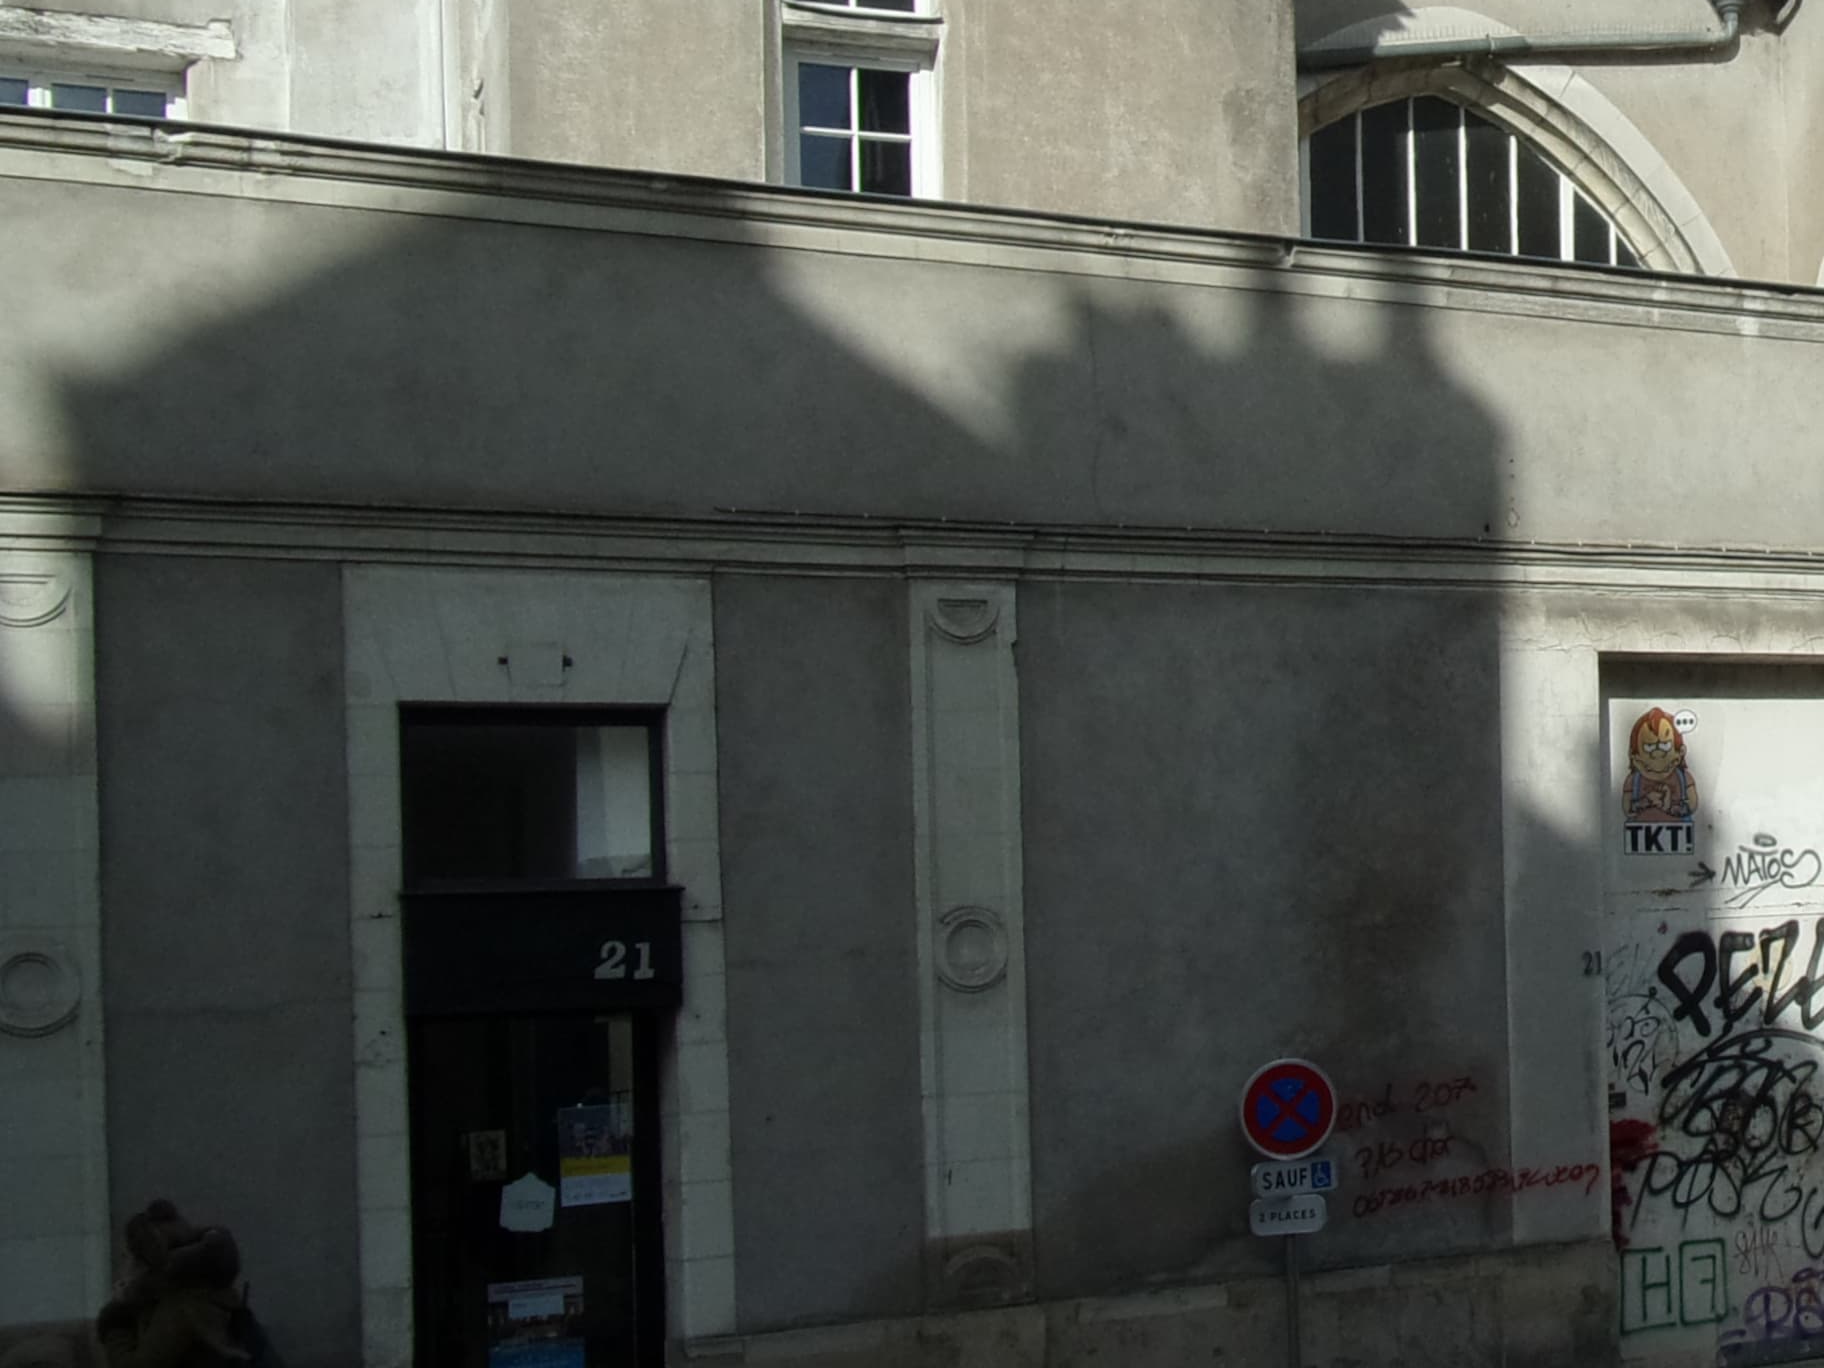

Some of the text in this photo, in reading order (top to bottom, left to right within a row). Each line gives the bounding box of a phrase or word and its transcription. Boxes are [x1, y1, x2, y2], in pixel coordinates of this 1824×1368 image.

[1625, 825, 1692, 852] TKT!
[594, 940, 656, 980] 21
[1262, 1167, 1308, 1191] SAUF
[1270, 1208, 1317, 1222] PLACES
